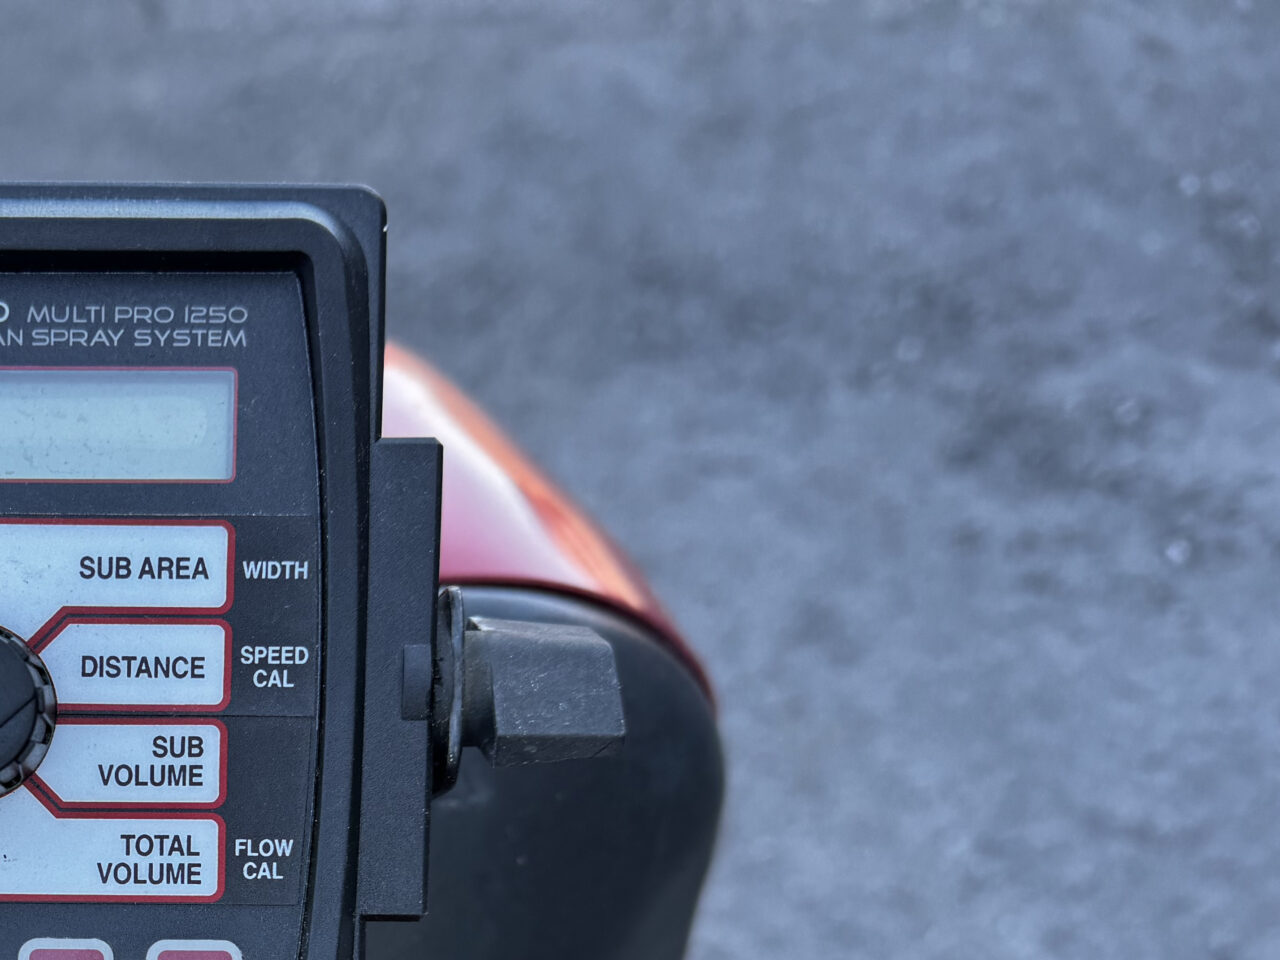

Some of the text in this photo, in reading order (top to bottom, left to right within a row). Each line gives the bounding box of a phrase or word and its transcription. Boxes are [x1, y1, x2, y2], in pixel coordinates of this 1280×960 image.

[27, 305, 248, 323] MULTI PRO 1250
[32, 329, 124, 346] SPRAY
[134, 330, 247, 347] SYSTEM
[79, 556, 209, 580] SUB AREA
[242, 560, 308, 580] WIDTH
[240, 646, 309, 665] SPEED
[81, 656, 205, 678] DISTANCE
[252, 670, 295, 688] CAL
[152, 735, 204, 758] SUB
[98, 764, 204, 787] VOLUME
[120, 834, 200, 857] TOTAL
[234, 838, 294, 857] FLOW
[97, 862, 202, 885] VOLUME
[242, 862, 284, 880] CAL
